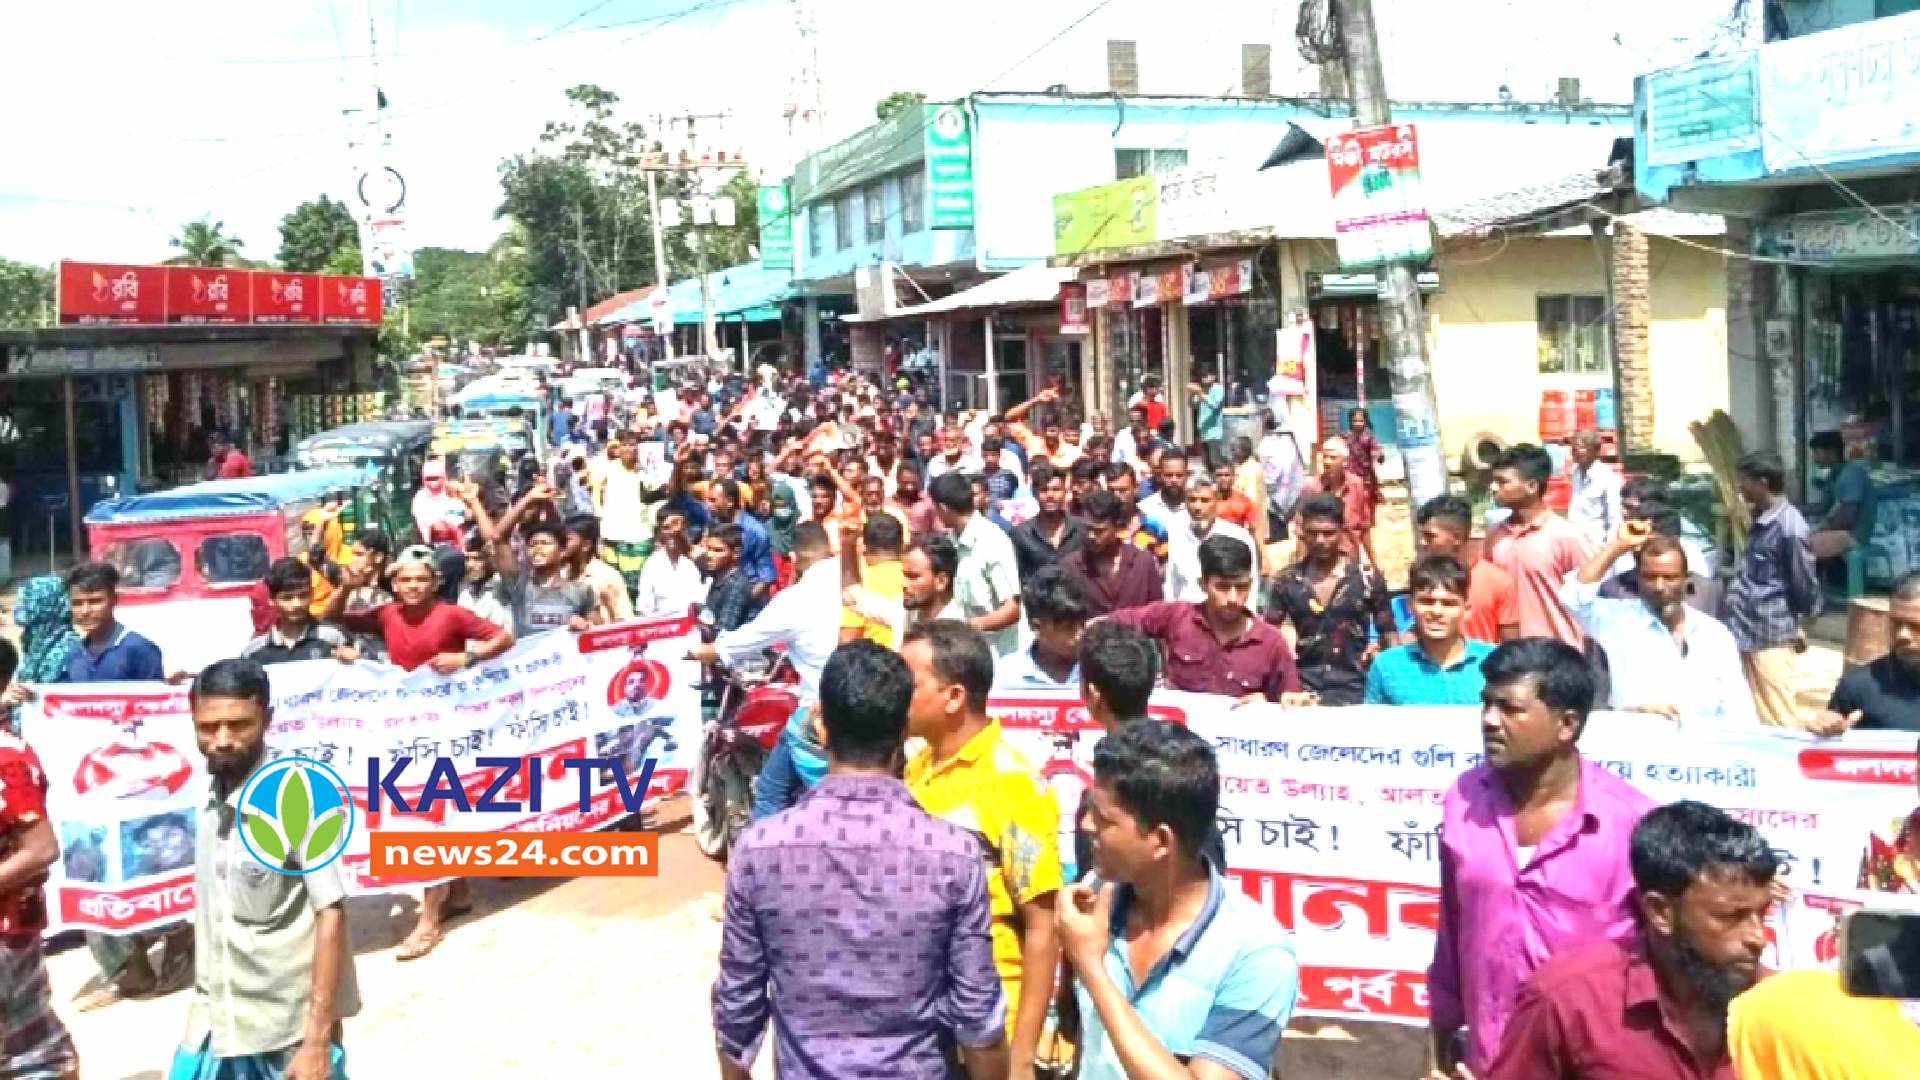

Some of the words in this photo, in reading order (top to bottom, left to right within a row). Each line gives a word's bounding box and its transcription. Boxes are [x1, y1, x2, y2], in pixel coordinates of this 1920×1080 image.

[112, 271, 138, 301] রবি
[207, 274, 228, 301] রবি
[1298, 743, 1400, 767] জেলেদের
[1411, 743, 1454, 769] গুলি
[1645, 759, 1756, 787] হত্যাকারী
[1379, 786, 1445, 805] আলত
[1323, 970, 1397, 1013] পূর্ব
